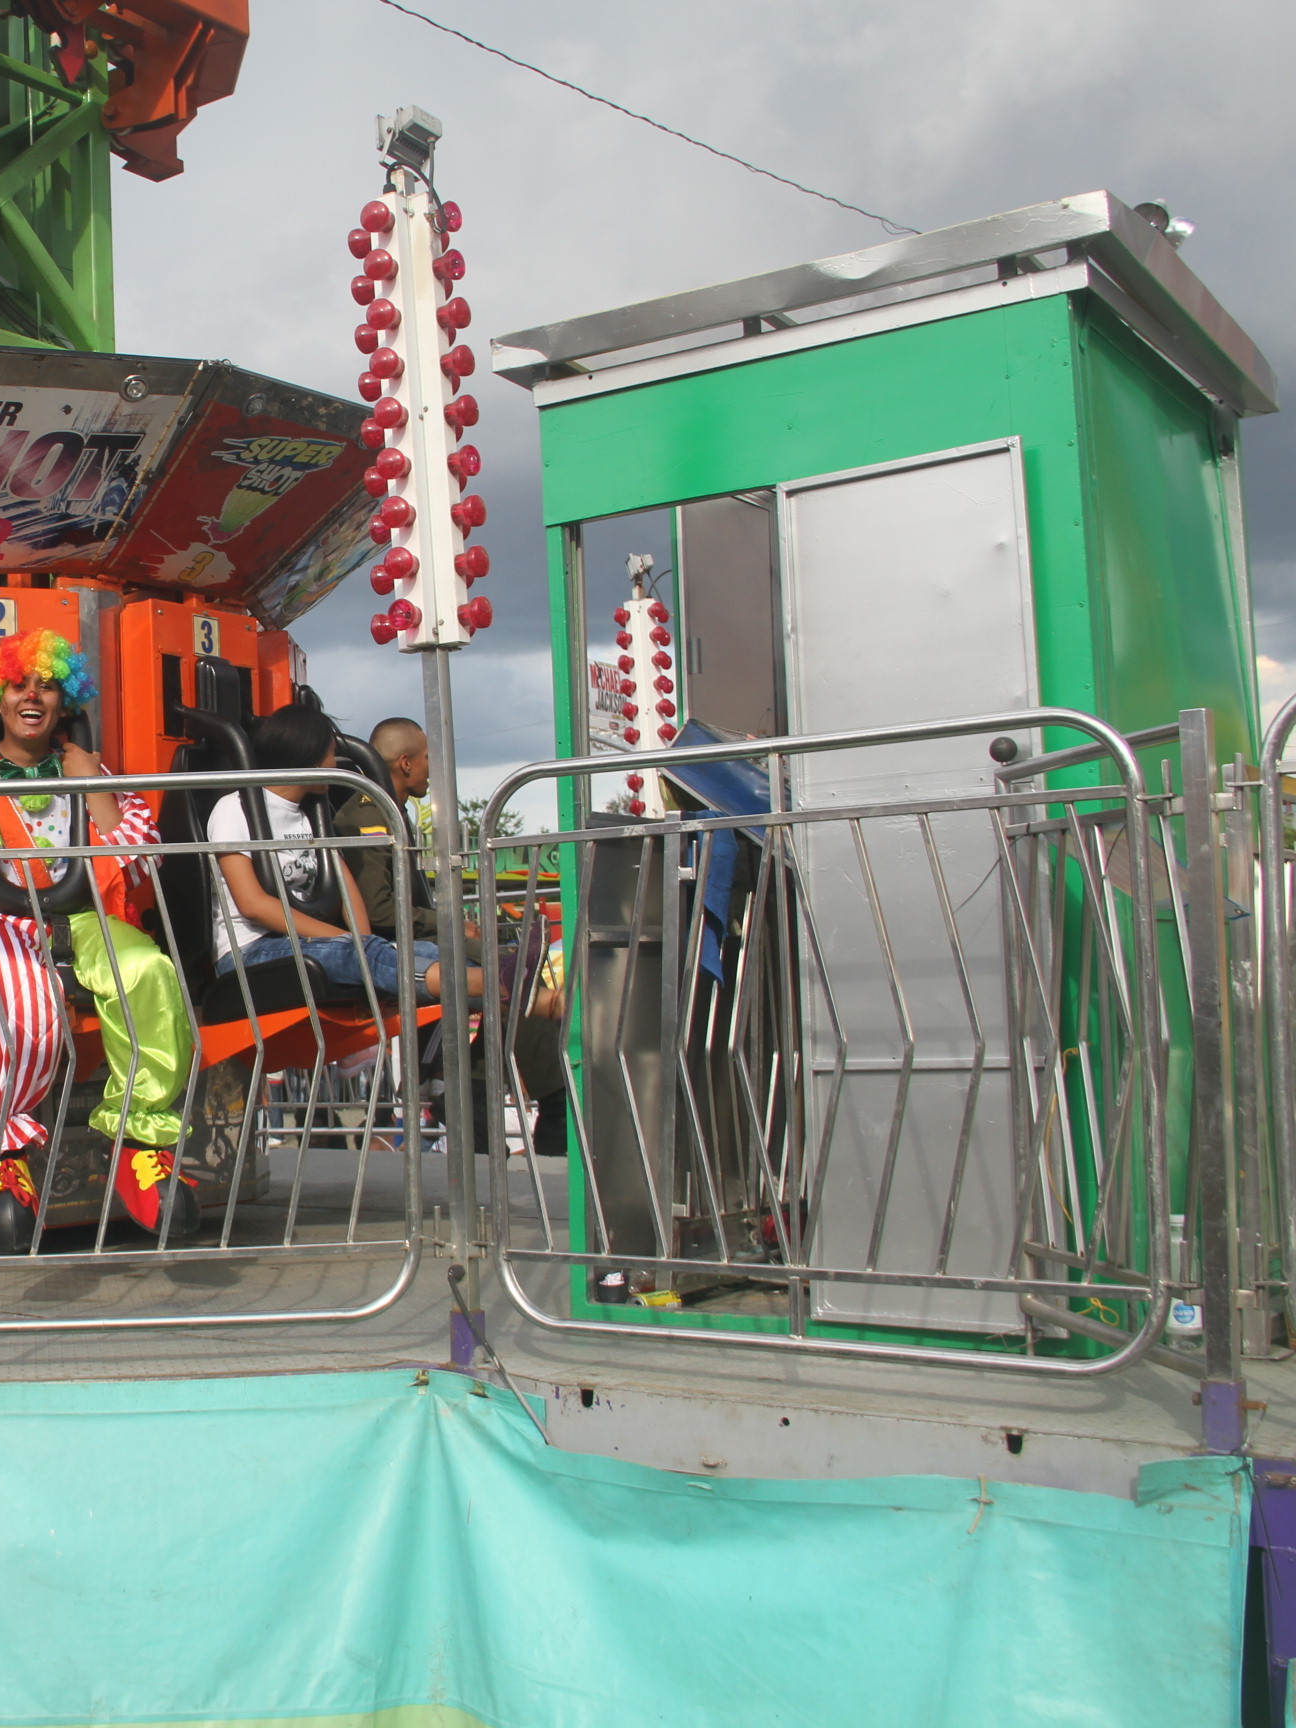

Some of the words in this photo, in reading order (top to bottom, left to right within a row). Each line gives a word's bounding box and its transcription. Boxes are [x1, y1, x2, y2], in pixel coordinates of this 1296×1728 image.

[241, 437, 346, 466] SUPER
[237, 463, 306, 497] SHOT
[178, 551, 212, 582] 3
[201, 619, 214, 654] 3
